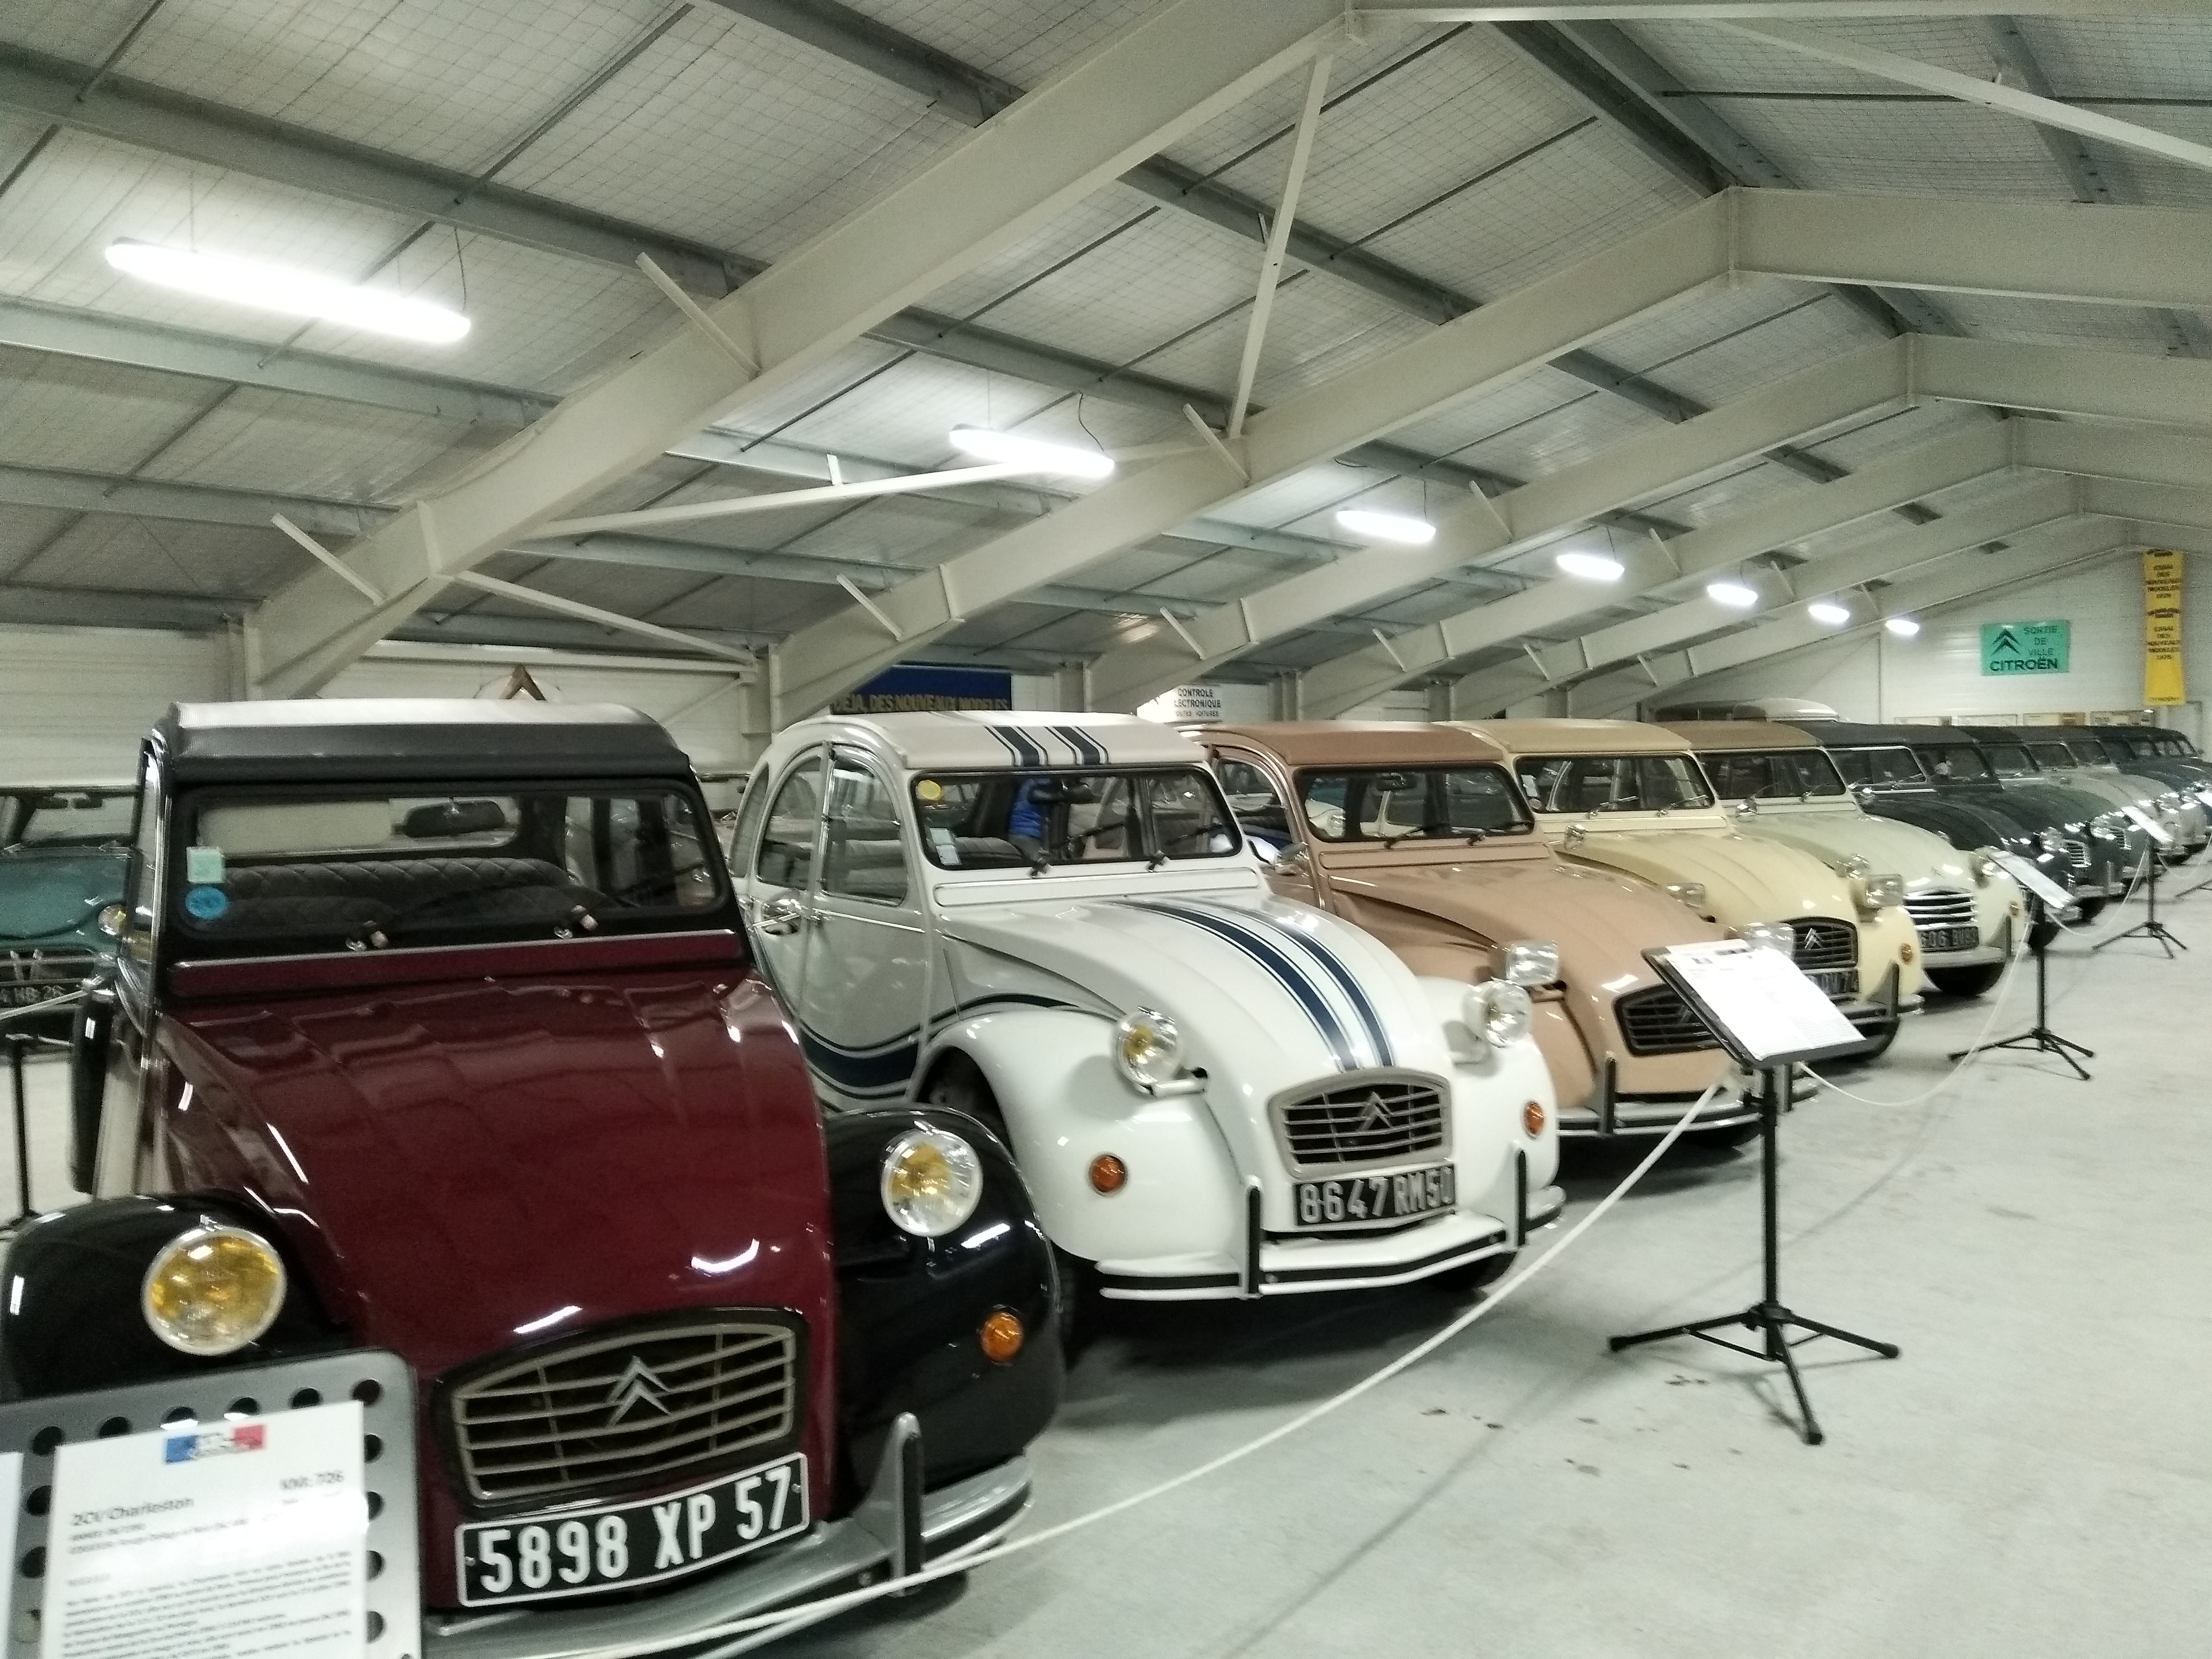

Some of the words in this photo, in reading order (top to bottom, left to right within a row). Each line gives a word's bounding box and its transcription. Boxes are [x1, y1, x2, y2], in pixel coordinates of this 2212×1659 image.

[2024, 626, 2057, 634] SORTIE
[1990, 655, 2058, 671] CITROËN
[1178, 688, 1214, 697] CONTROLE
[1174, 699, 1221, 708] LECTRONIQUE
[1299, 1176, 1389, 1224] 8647
[71, 1511, 103, 1526] 2CV
[107, 1497, 193, 1520] Charleston
[479, 1515, 629, 1594] 5898
[652, 1493, 716, 1570] XP
[734, 1465, 792, 1541] 57
